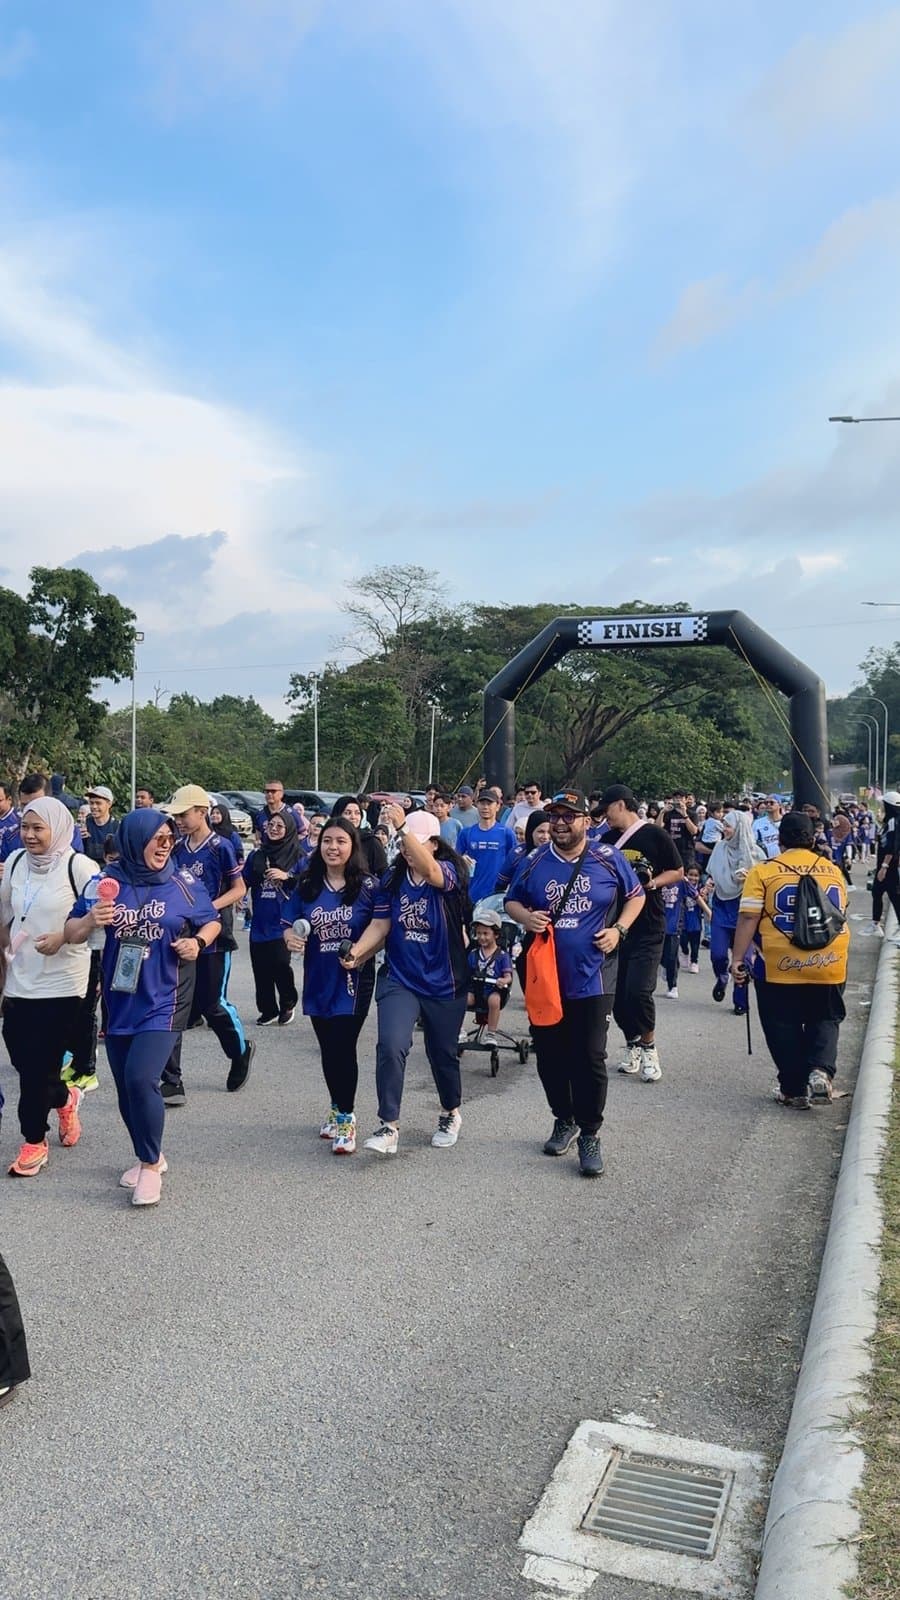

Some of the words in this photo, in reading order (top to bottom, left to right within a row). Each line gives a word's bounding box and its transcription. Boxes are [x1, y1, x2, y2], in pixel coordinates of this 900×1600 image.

[603, 622, 682, 640] FINISH
[545, 874, 591, 901] Sprts
[311, 904, 353, 926] Sports
[549, 895, 592, 915] Festa
[313, 921, 353, 941] Fiesta
[405, 930, 430, 943] 2025
